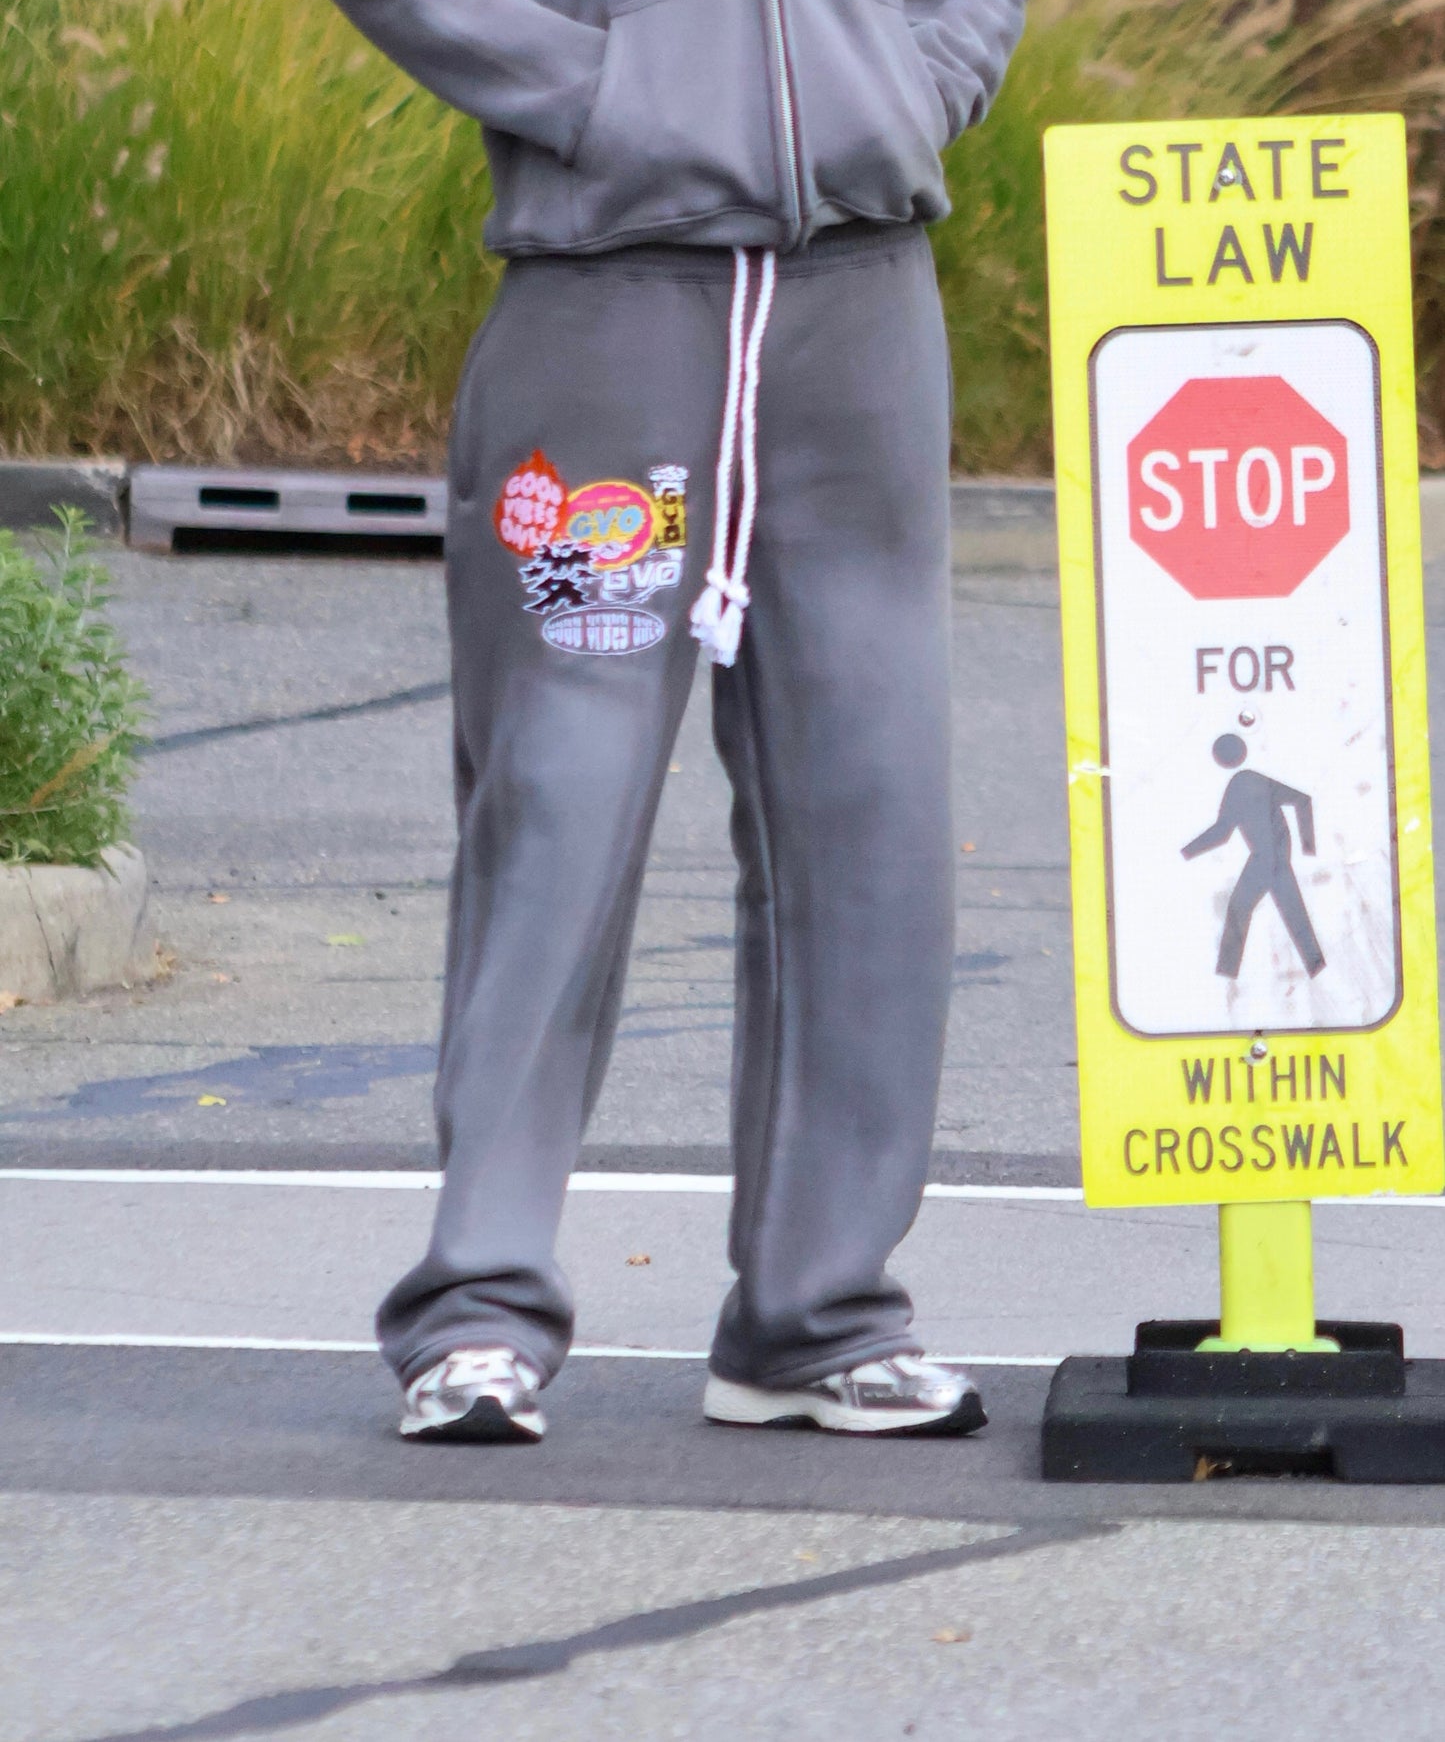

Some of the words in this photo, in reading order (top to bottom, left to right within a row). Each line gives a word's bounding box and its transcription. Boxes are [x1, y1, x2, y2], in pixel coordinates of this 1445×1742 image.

[1118, 139, 1350, 206] STATE
[1155, 222, 1314, 288] LAW
[505, 471, 563, 506] GOOD
[1139, 445, 1337, 533] STOP
[602, 559, 682, 591] GVO
[1195, 645, 1296, 695] FOR
[1181, 1053, 1347, 1105] WITHIN
[1123, 1120, 1409, 1177] CROSSWALK
